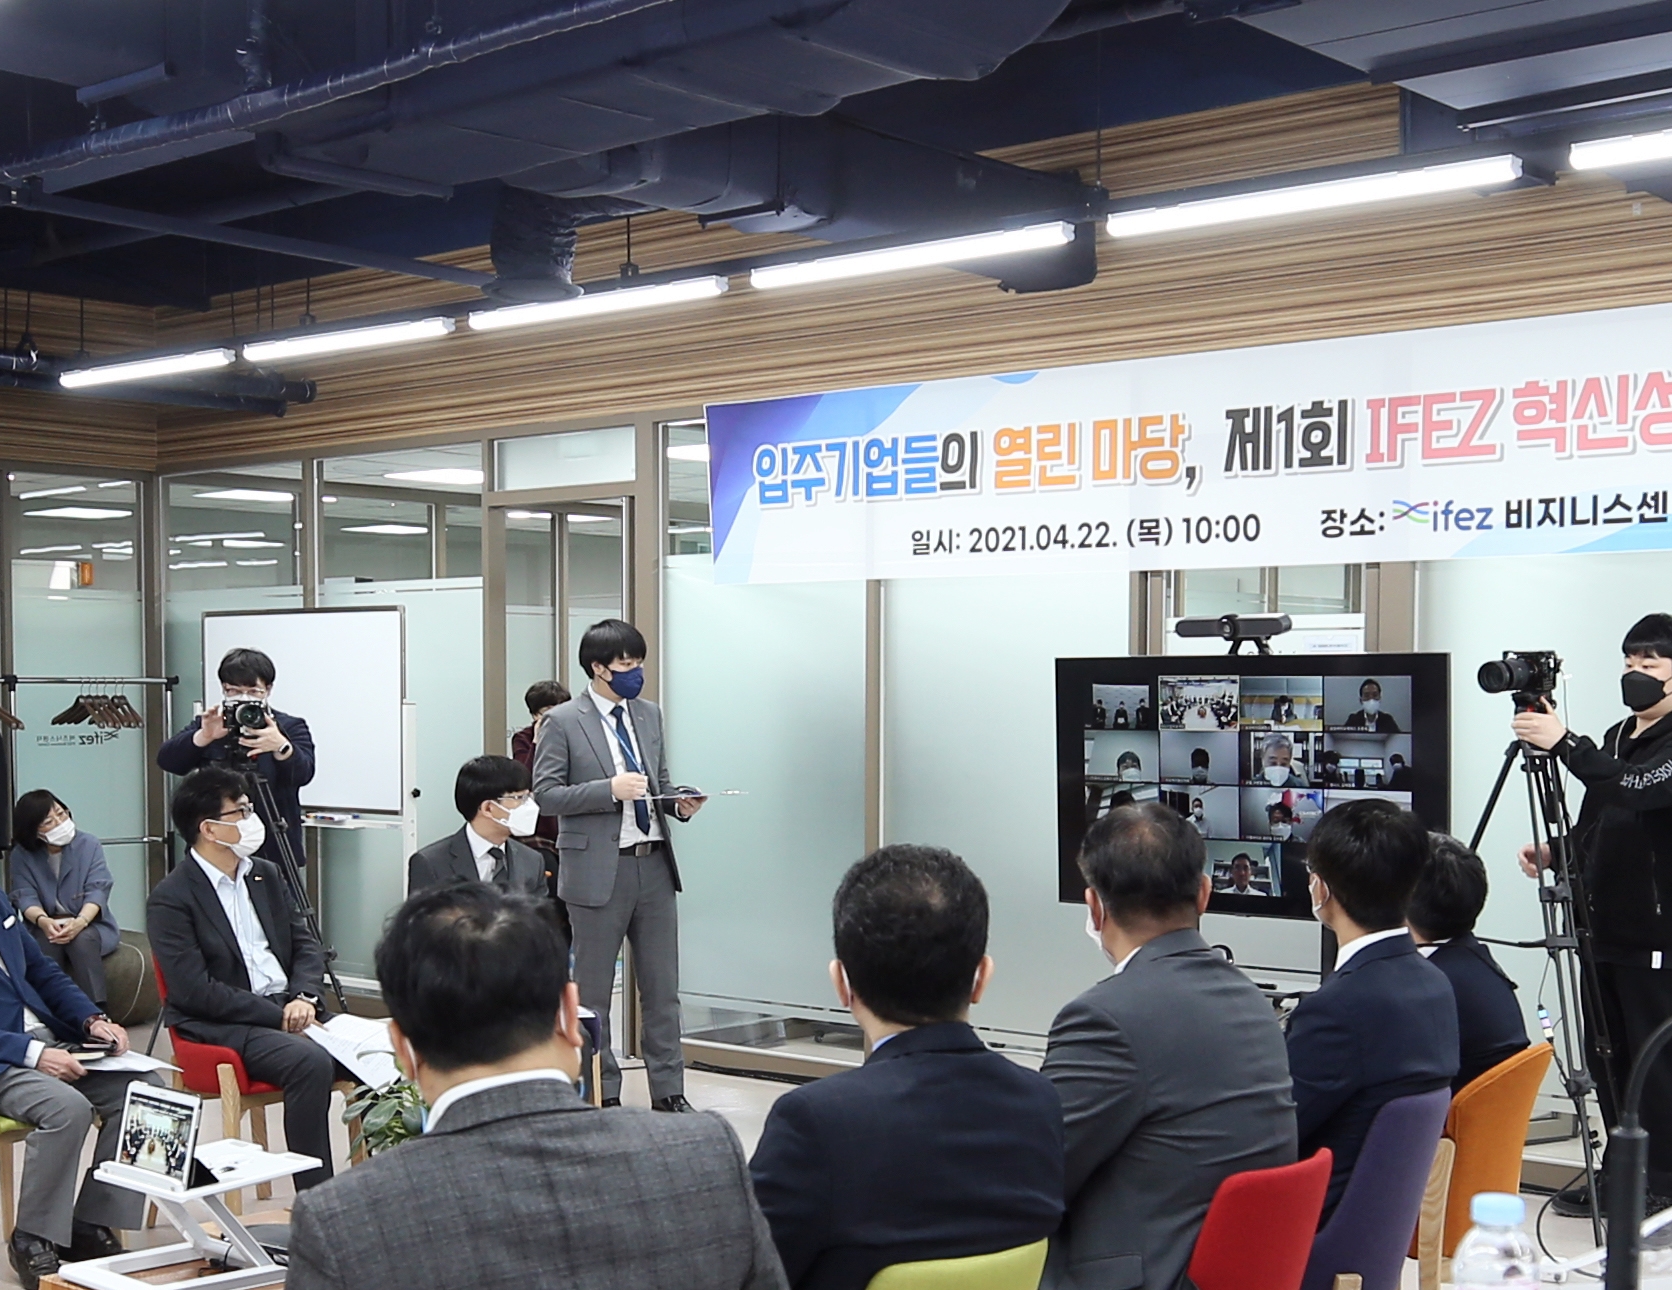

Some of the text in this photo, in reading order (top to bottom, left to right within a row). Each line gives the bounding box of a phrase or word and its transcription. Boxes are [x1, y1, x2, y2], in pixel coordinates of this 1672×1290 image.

[752, 430, 981, 506] 입주기업들의
[991, 420, 1079, 489] 열린
[1090, 410, 1204, 492] 마당,
[1223, 398, 1350, 475] 제1회
[1364, 387, 1499, 464] IFEZ
[910, 529, 963, 557] 일시:
[968, 522, 1119, 555] 2021.04.22.
[1126, 515, 1175, 549] (목)
[1182, 511, 1262, 545] 10:00
[1319, 507, 1387, 541] 장소:
[1430, 499, 1494, 532] ifez
